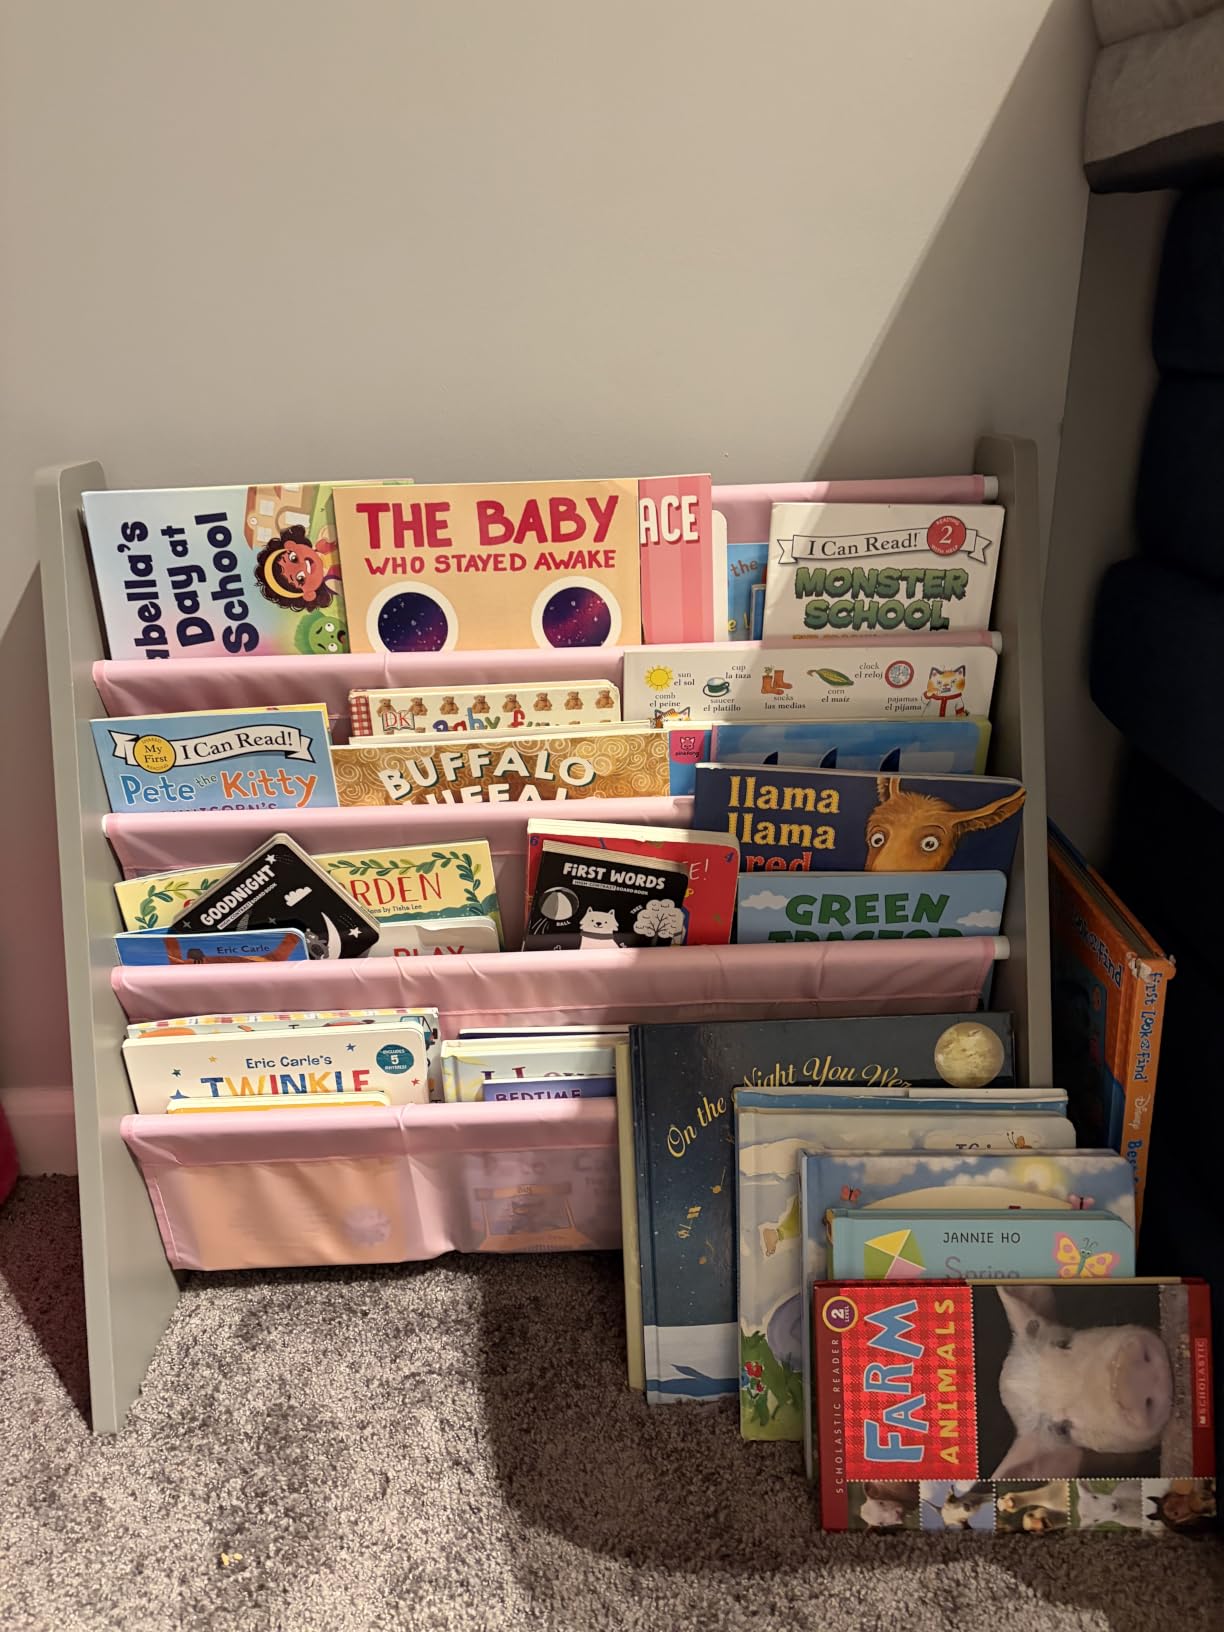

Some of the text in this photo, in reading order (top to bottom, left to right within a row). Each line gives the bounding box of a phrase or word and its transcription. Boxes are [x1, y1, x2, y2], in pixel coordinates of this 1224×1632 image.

[356, 495, 619, 549] THE BABY
[808, 541, 815, 556] I
[821, 540, 859, 557] Can
[865, 532, 919, 552] Read!
[938, 525, 953, 545] 2
[364, 550, 617, 576] WHO STAYED AWAKE
[730, 559, 759, 577] the
[161, 525, 215, 647] Day at
[194, 512, 260, 654] School
[794, 566, 969, 600] MONSTER
[803, 599, 950, 631] SCHOOL
[731, 664, 746, 673] cup
[854, 671, 883, 681] el reloj
[859, 662, 880, 670] clock
[655, 692, 676, 700] comb
[659, 700, 681, 708] peine
[713, 704, 741, 713] platillo
[887, 696, 918, 704] pajamas
[383, 710, 413, 730] DK
[144, 745, 163, 754] My
[181, 731, 293, 760] I Can Read!
[144, 754, 168, 764] First
[378, 748, 596, 799] BUFFALO
[120, 768, 318, 808] Pete the Kitty
[728, 775, 841, 814] llama
[727, 812, 836, 849] llama
[746, 851, 813, 872] red
[610, 870, 666, 890] WORDS
[630, 905, 644, 915] TREE
[785, 893, 950, 926] GREEN
[217, 944, 270, 954] Eric Carle
[245, 1055, 332, 1070] Eric Carle's
[390, 1054, 399, 1065] 5
[200, 1069, 371, 1098] TWINKLE
[666, 1124, 697, 1158] On
[696, 1092, 727, 1127] the
[739, 1062, 796, 1090] Night
[802, 1056, 857, 1087] You
[1127, 1140, 1143, 1170] Bes
[943, 1232, 1021, 1244] JANNIE HO
[831, 1308, 845, 1319] 2
[864, 1299, 929, 1463] FARM
[934, 1299, 960, 1465] ANIMALS
[1196, 1340, 1207, 1416] SCHOLASTIC
[831, 1339, 845, 1494] SCHOLASTIC READER
